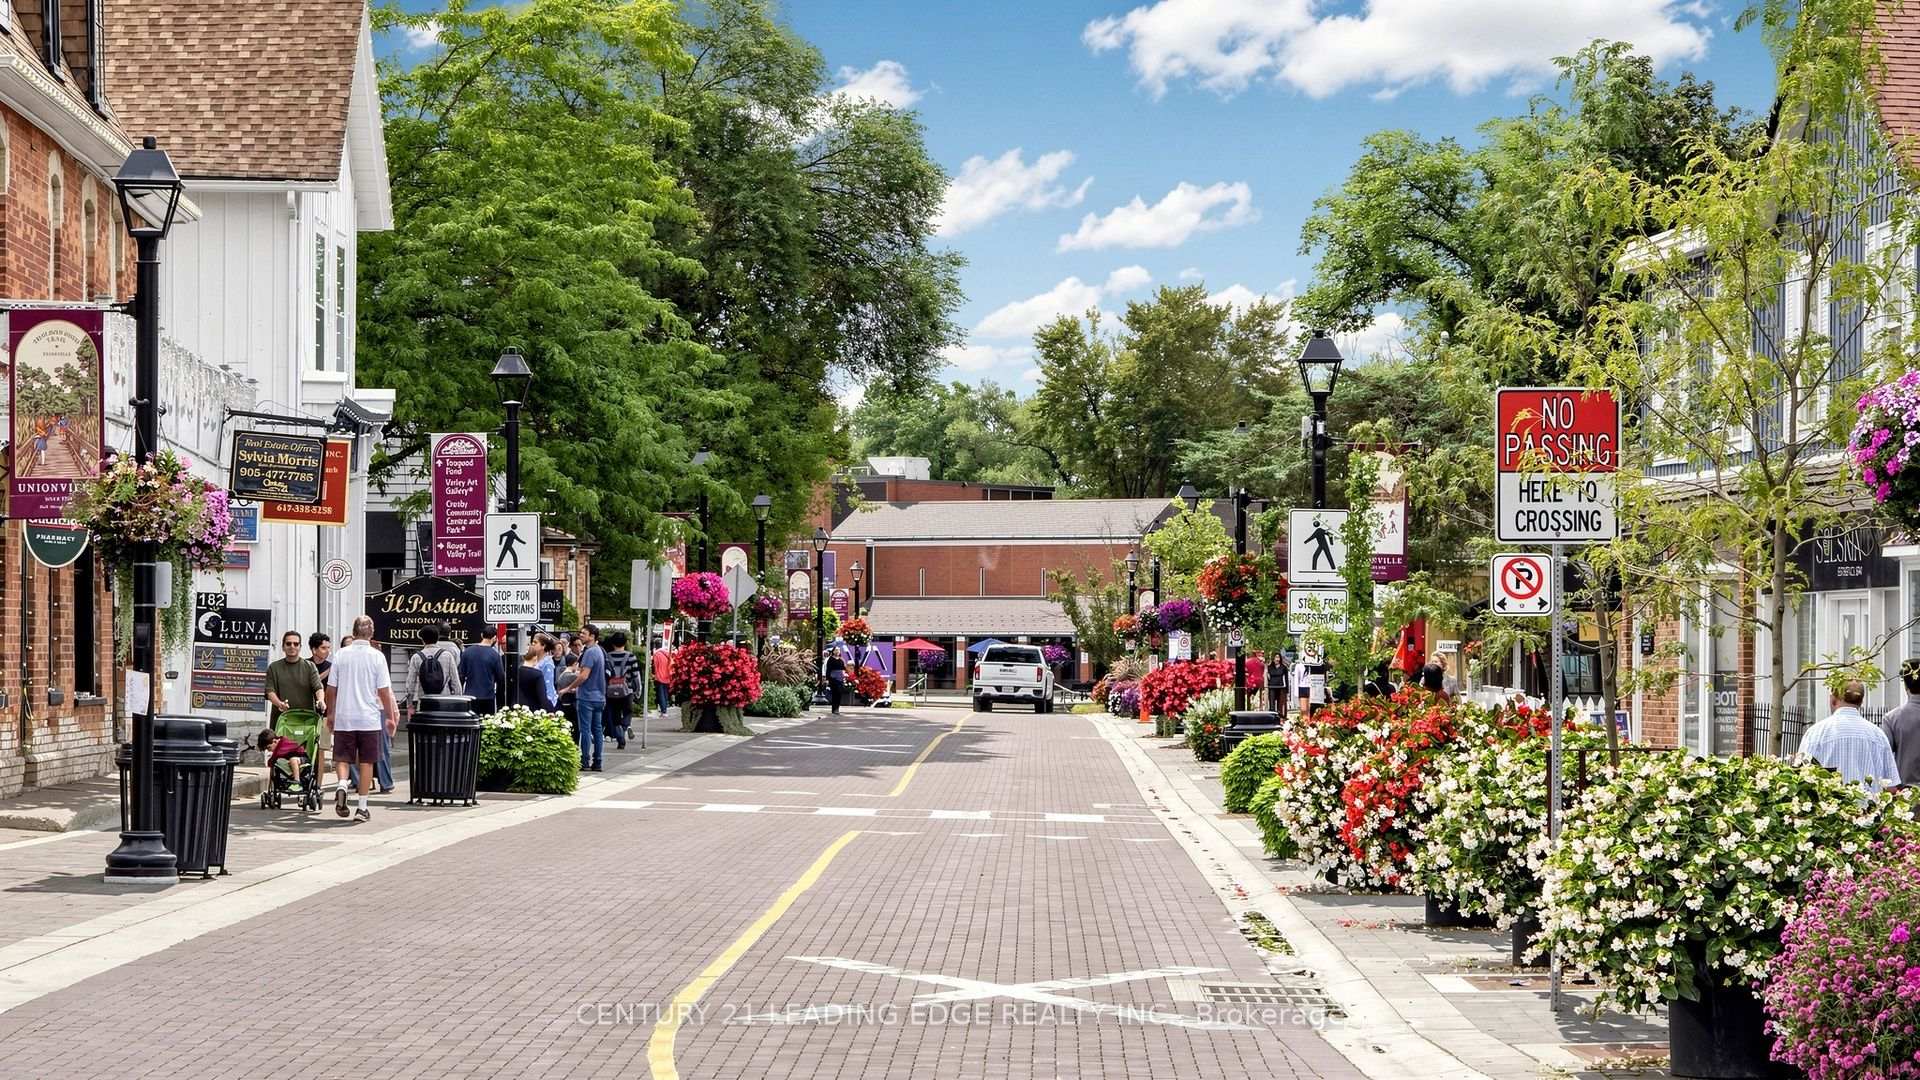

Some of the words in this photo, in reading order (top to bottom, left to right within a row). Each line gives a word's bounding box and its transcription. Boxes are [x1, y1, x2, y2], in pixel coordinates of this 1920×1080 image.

[1542, 397, 1574, 430] NO
[238, 449, 275, 463] Sylvia
[277, 453, 318, 468] Morris
[1504, 433, 1610, 467] PASSING
[446, 459, 474, 468] Toogood
[1519, 480, 1562, 504] HERE
[1577, 480, 1598, 504] TO
[468, 517, 482, 525] and
[1515, 510, 1602, 532] CROSSING
[199, 594, 224, 606] 182
[382, 594, 404, 613] Il
[406, 594, 478, 614] Postino
[493, 590, 512, 602] STOP
[516, 590, 530, 602] FOR
[488, 604, 535, 615] PEDESTRIANS
[220, 620, 268, 634] LUNA
